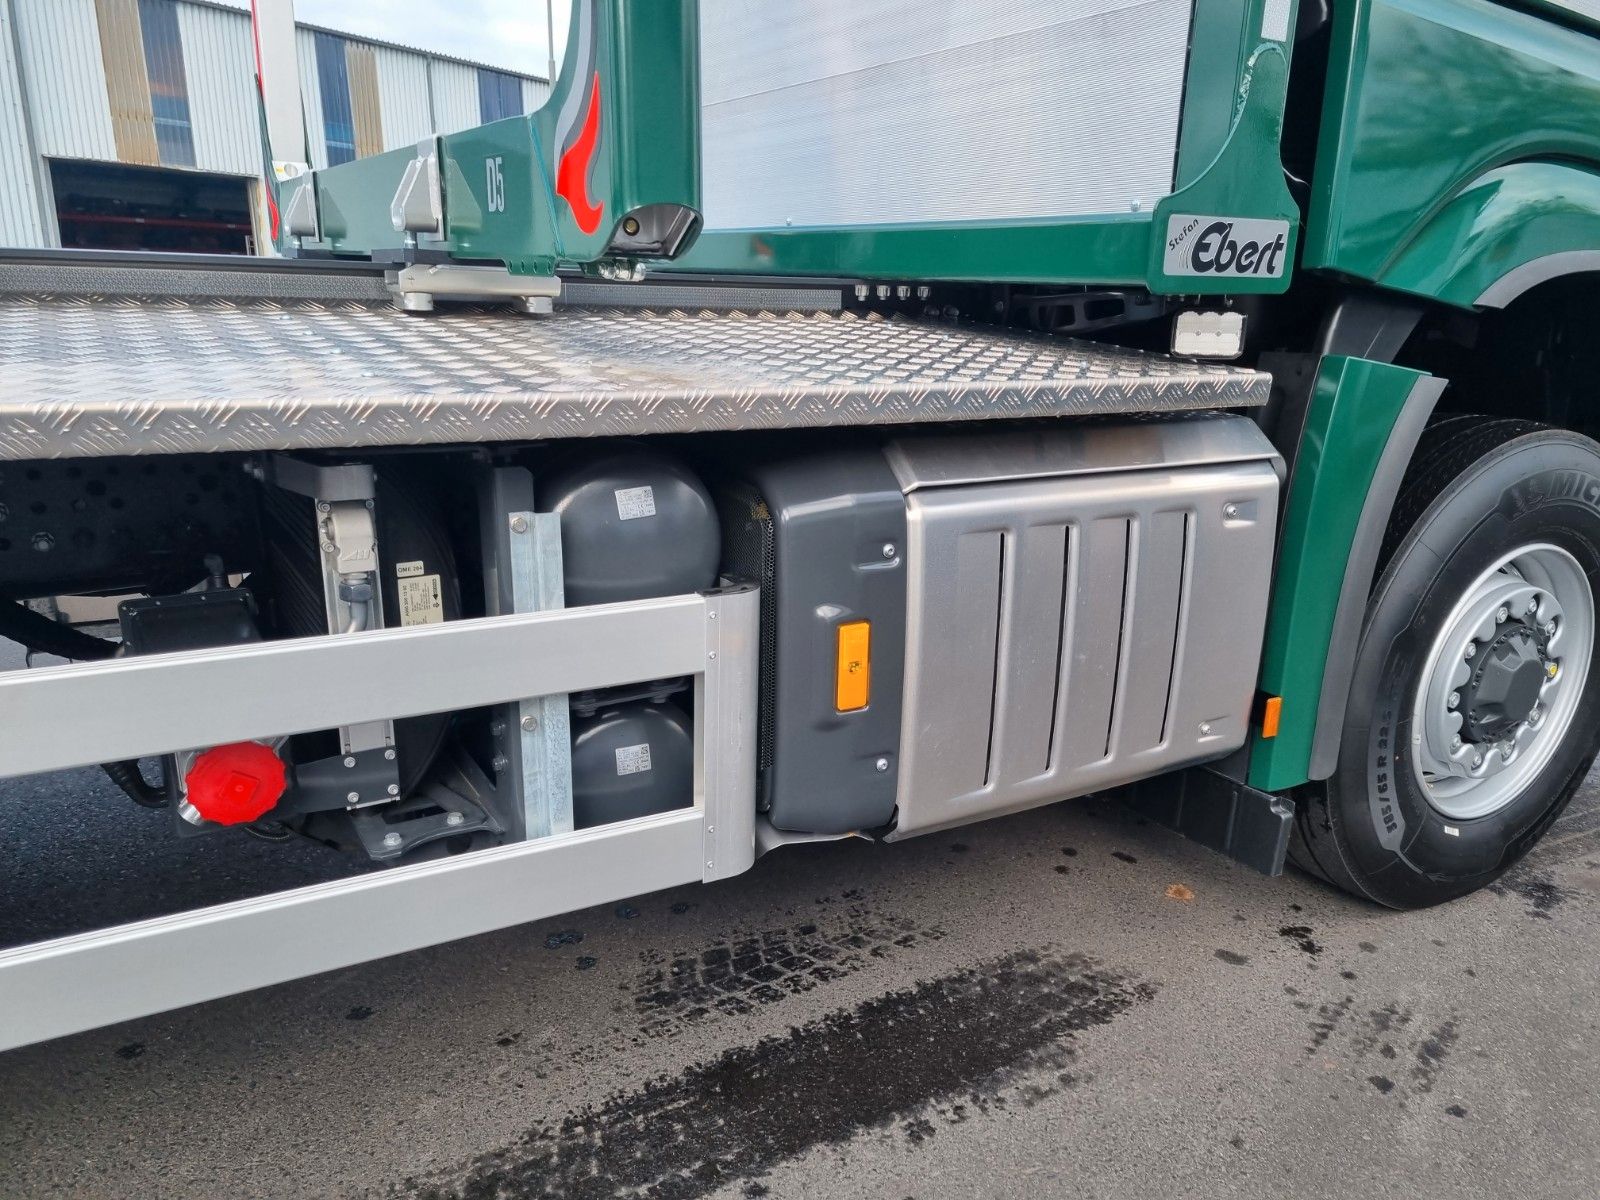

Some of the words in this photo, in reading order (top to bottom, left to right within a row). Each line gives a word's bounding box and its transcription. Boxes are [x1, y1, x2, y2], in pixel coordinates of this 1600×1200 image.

[486, 156, 505, 212] D5
[1168, 218, 1199, 251] Stefan
[1191, 221, 1285, 275] Ebert
[1377, 754, 1388, 769] R
